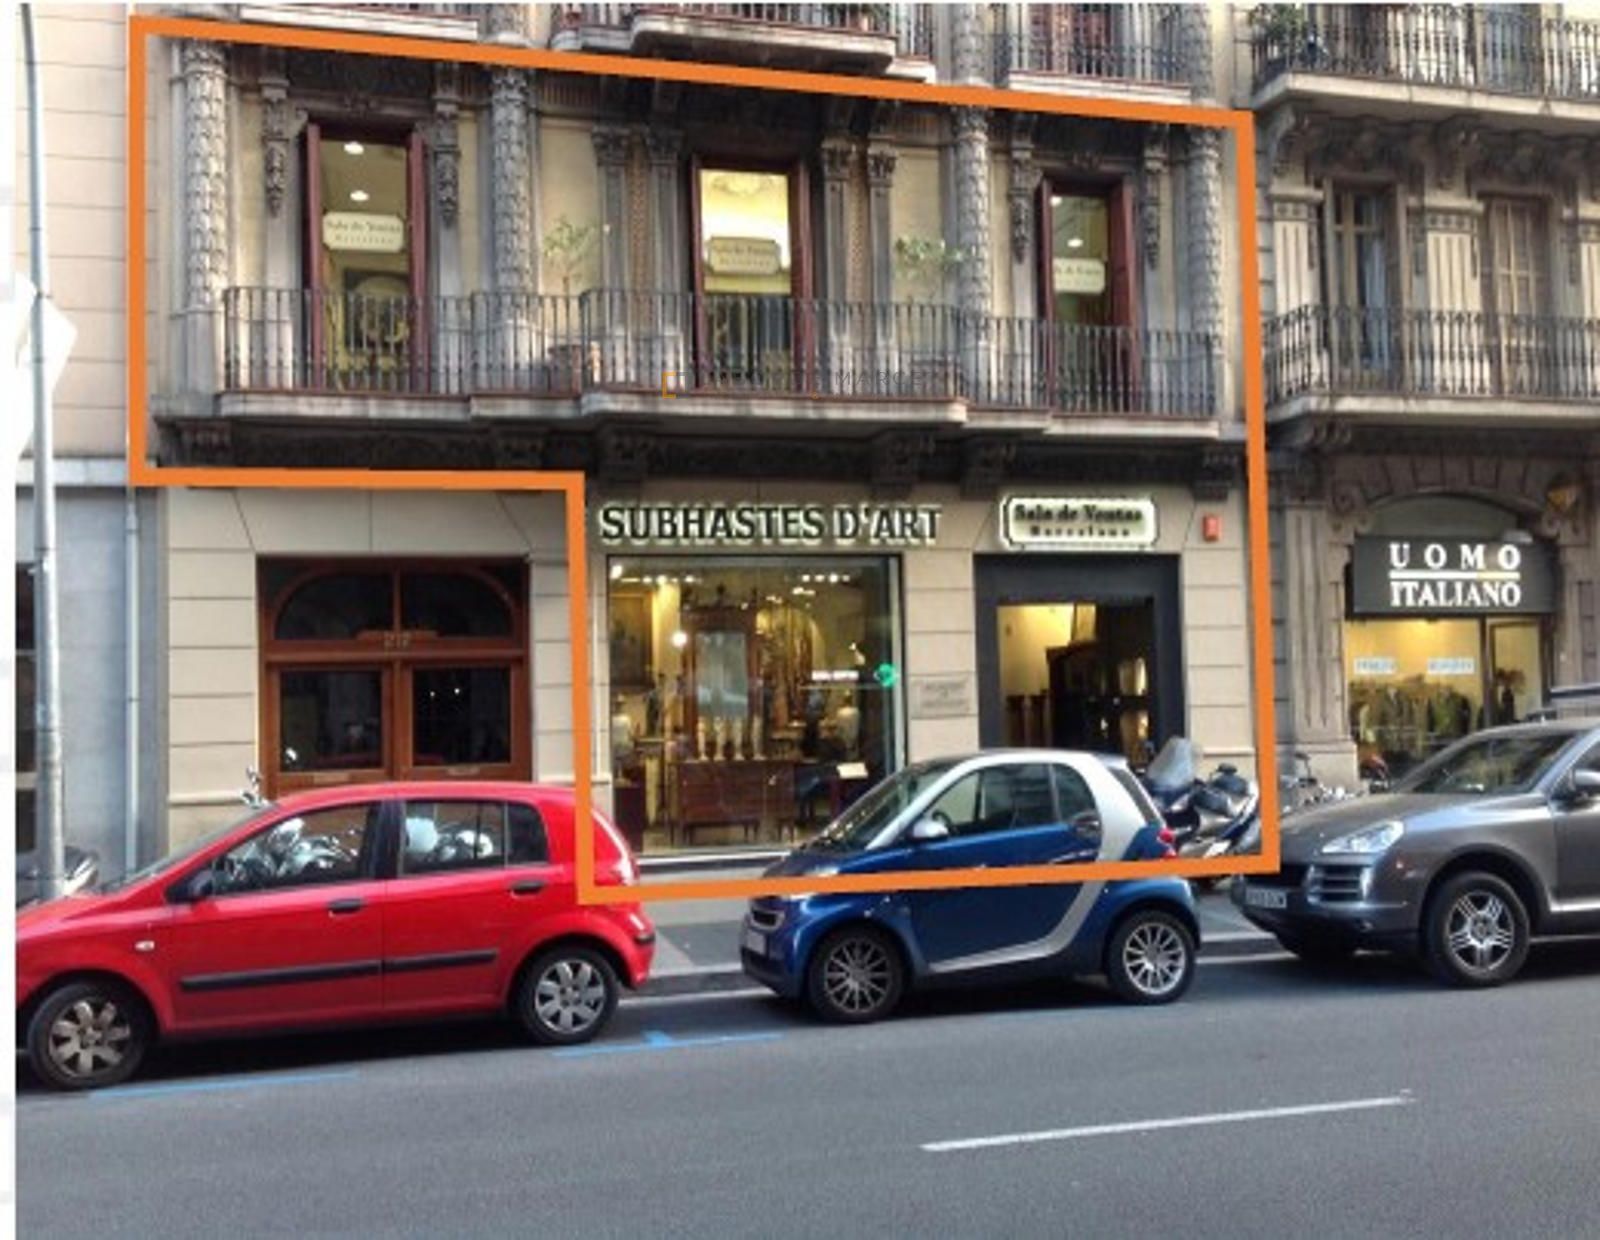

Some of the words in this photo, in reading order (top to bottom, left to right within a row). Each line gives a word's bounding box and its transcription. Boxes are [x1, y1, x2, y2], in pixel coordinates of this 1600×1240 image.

[600, 504, 827, 543] SUBHASTES
[835, 504, 941, 543] D'ART
[1014, 504, 1052, 520] Sala
[1057, 504, 1077, 520] de
[1389, 581, 1521, 608] ITALIANO
